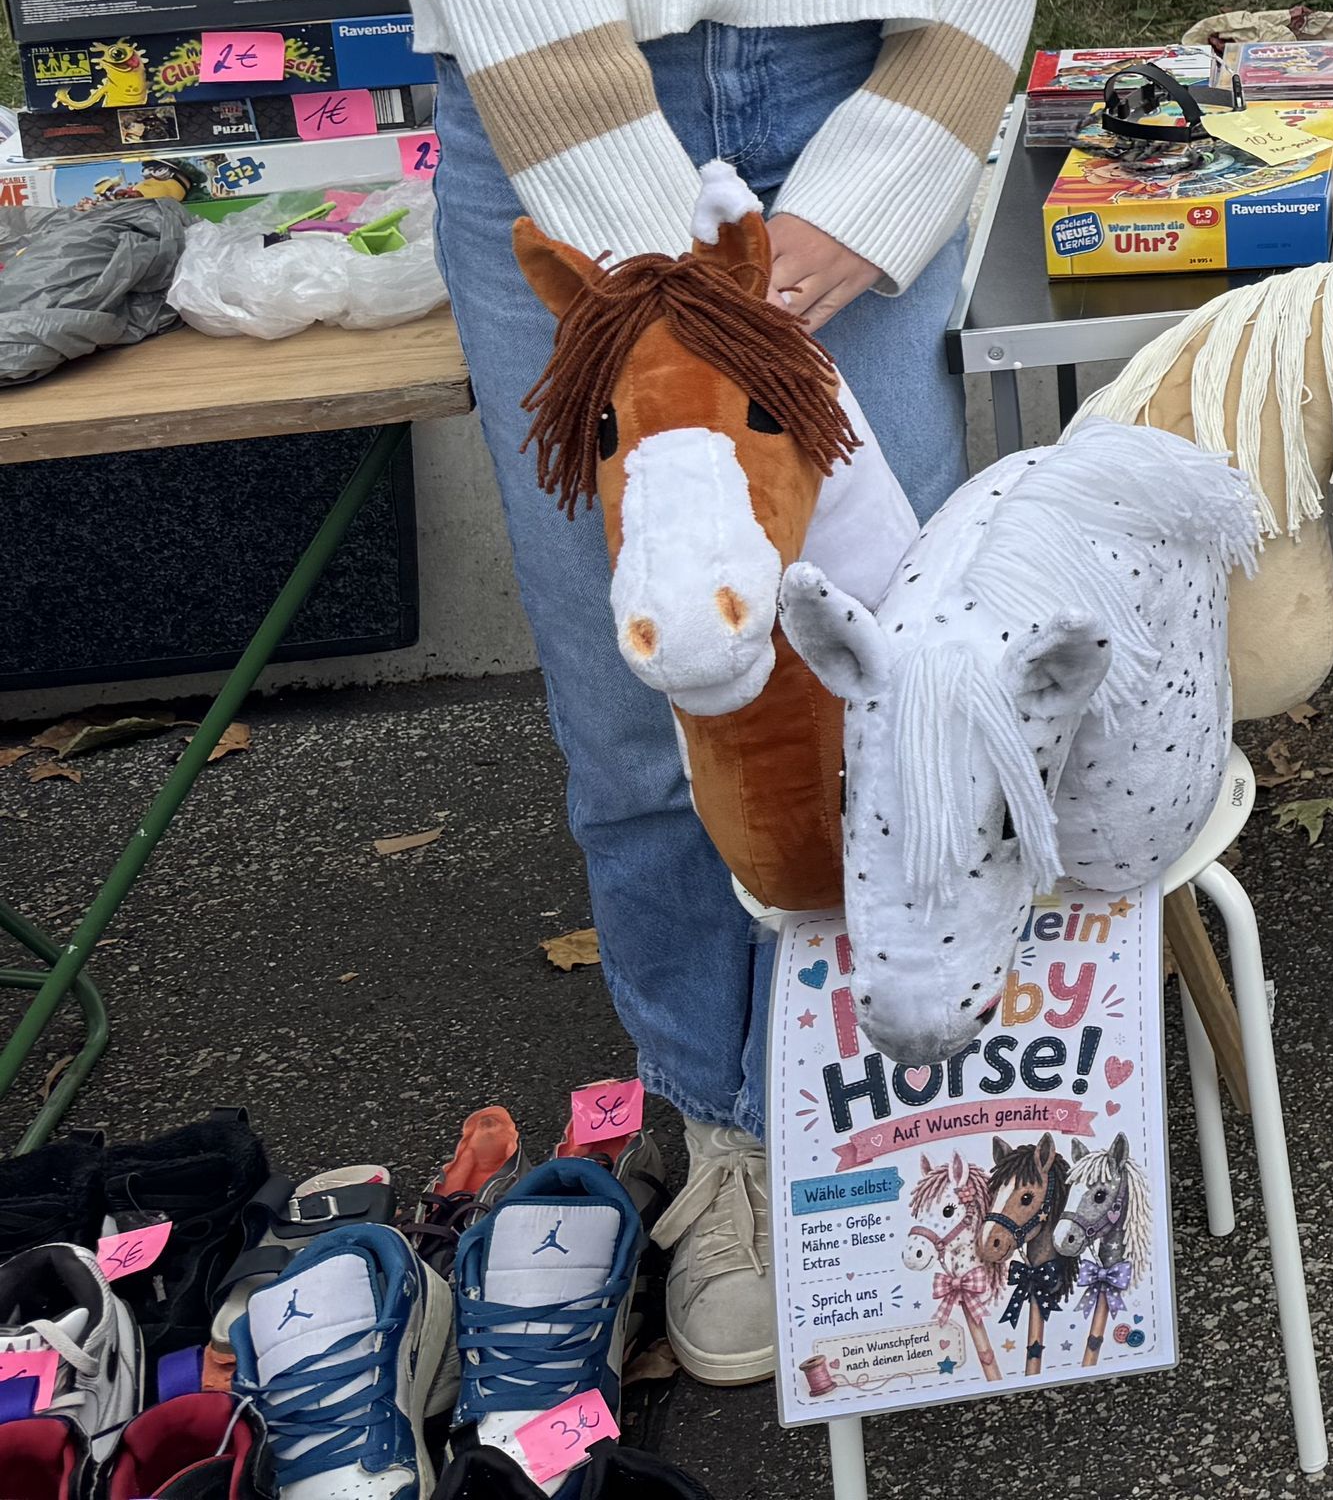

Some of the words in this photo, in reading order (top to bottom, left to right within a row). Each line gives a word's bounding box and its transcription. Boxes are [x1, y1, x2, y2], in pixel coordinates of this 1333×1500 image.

[212, 42, 259, 75] 2€
[303, 96, 349, 131] 1€
[414, 142, 440, 171] 2
[225, 164, 255, 182] 212
[1192, 208, 1213, 219] 6-9
[1231, 202, 1321, 216] Ravensburger
[1055, 214, 1094, 231] spielend
[1056, 224, 1098, 242] NEUES
[1108, 222, 1132, 233] Wer
[1133, 222, 1165, 233] kennt
[1167, 221, 1186, 231] die
[1058, 235, 1100, 251] LERNEN
[1114, 231, 1181, 254] Uhr?
[822, 1025, 1104, 1134] Horse!
[892, 1120, 923, 1143] Auf
[926, 1107, 990, 1133] Wunsch
[994, 1104, 1050, 1128] genäht
[804, 1186, 847, 1204] Wähle
[850, 1181, 893, 1198] selbst:
[801, 1221, 834, 1236] Farbe
[845, 1213, 882, 1230] Größe
[801, 1236, 840, 1253] Mähne
[851, 1231, 886, 1247] Blesse
[802, 1256, 841, 1272] Extras
[811, 1289, 852, 1311] Sprich
[856, 1288, 878, 1301] uns
[812, 1309, 859, 1327] einfach
[862, 1303, 884, 1319] an!
[842, 1345, 864, 1358] Dein
[866, 1331, 930, 1352] Wunschpferd
[845, 1359, 870, 1372] nach
[872, 1354, 904, 1368] deinen
[906, 1348, 933, 1361] Ideen
[550, 1405, 601, 1451] 3€
